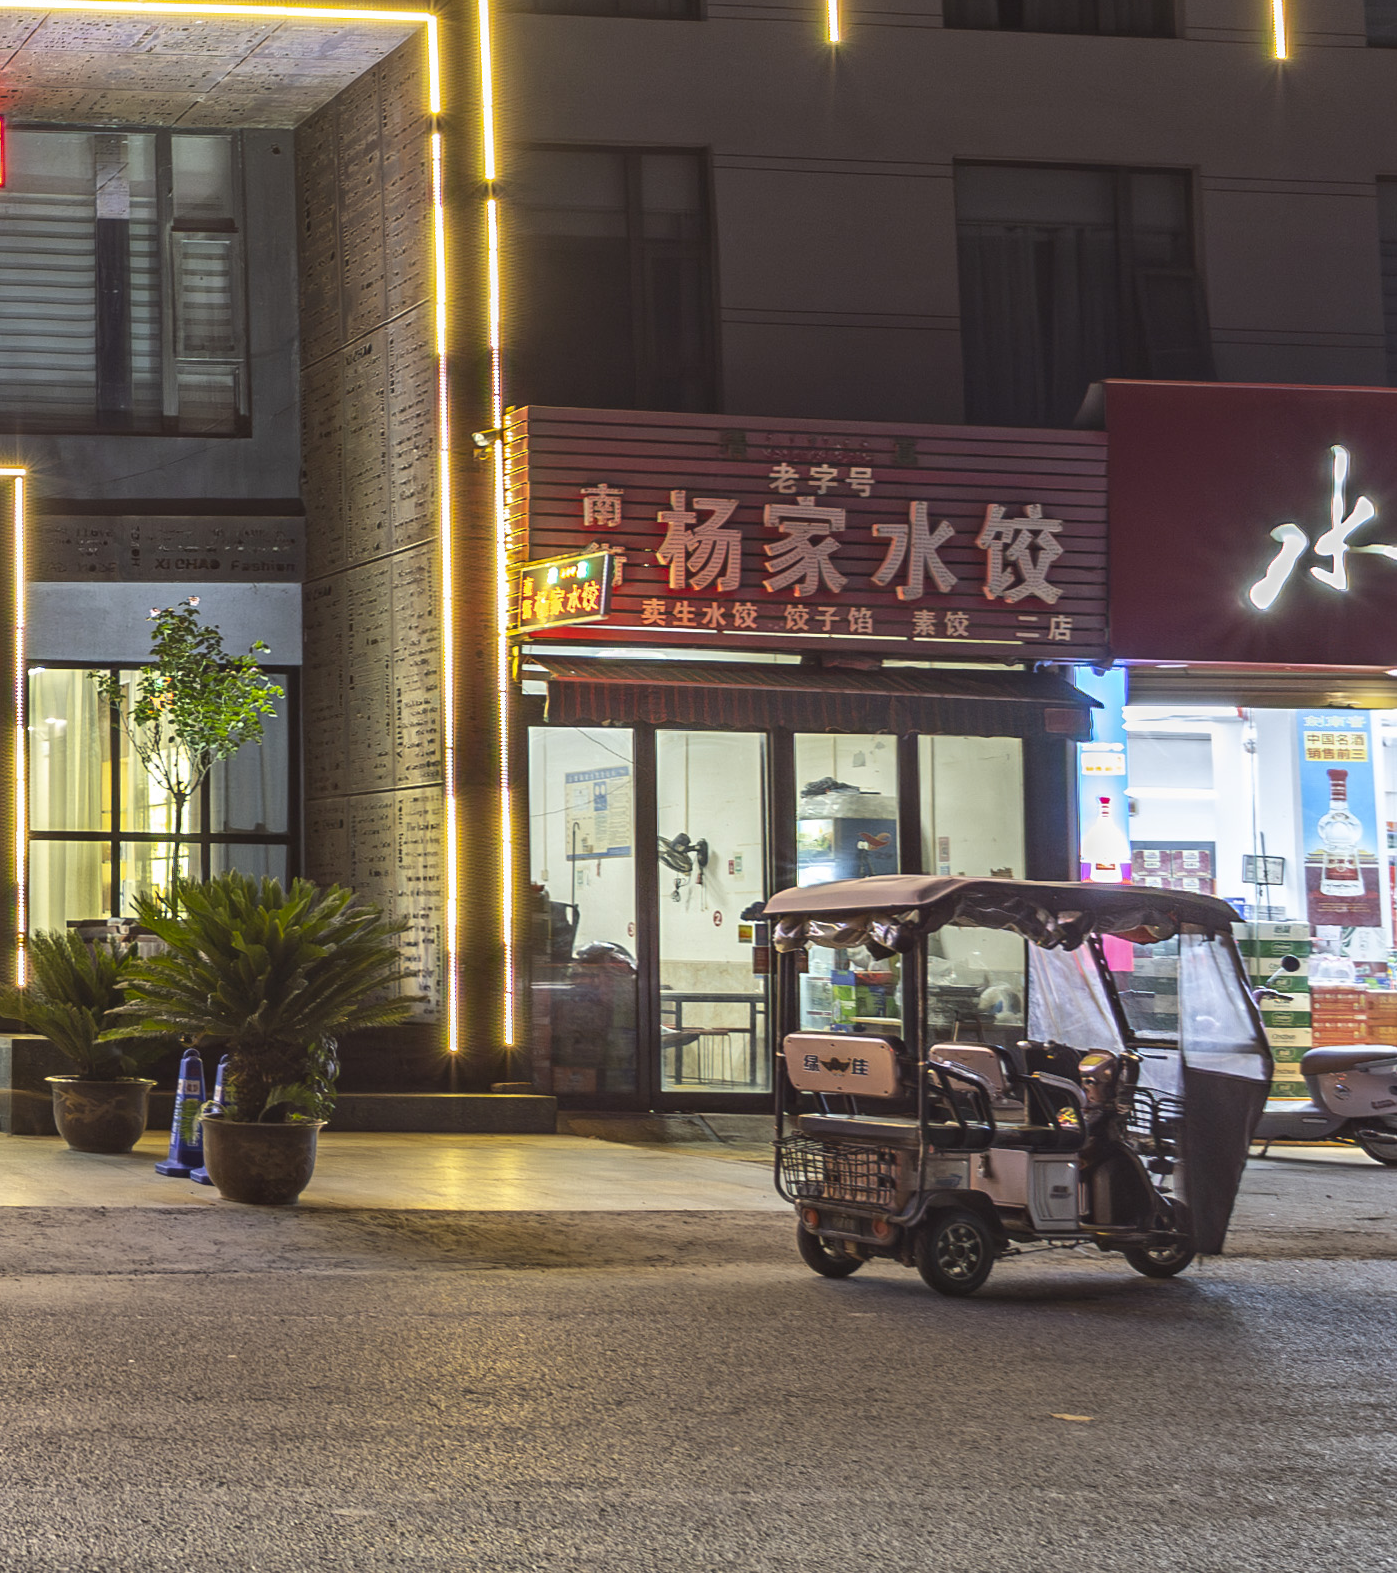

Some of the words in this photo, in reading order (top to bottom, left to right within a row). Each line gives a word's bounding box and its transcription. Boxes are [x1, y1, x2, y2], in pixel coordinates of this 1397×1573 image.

[768, 462, 876, 498] 老字号
[656, 489, 1065, 604] 杨家水饺
[641, 598, 758, 629] 卖生水饺
[784, 604, 874, 635] 饺子馅
[912, 610, 970, 637] 素饺
[1015, 614, 1073, 642] 二店
[1306, 733, 1365, 746] 中国名酒
[1306, 747, 1366, 760] 销售前三
